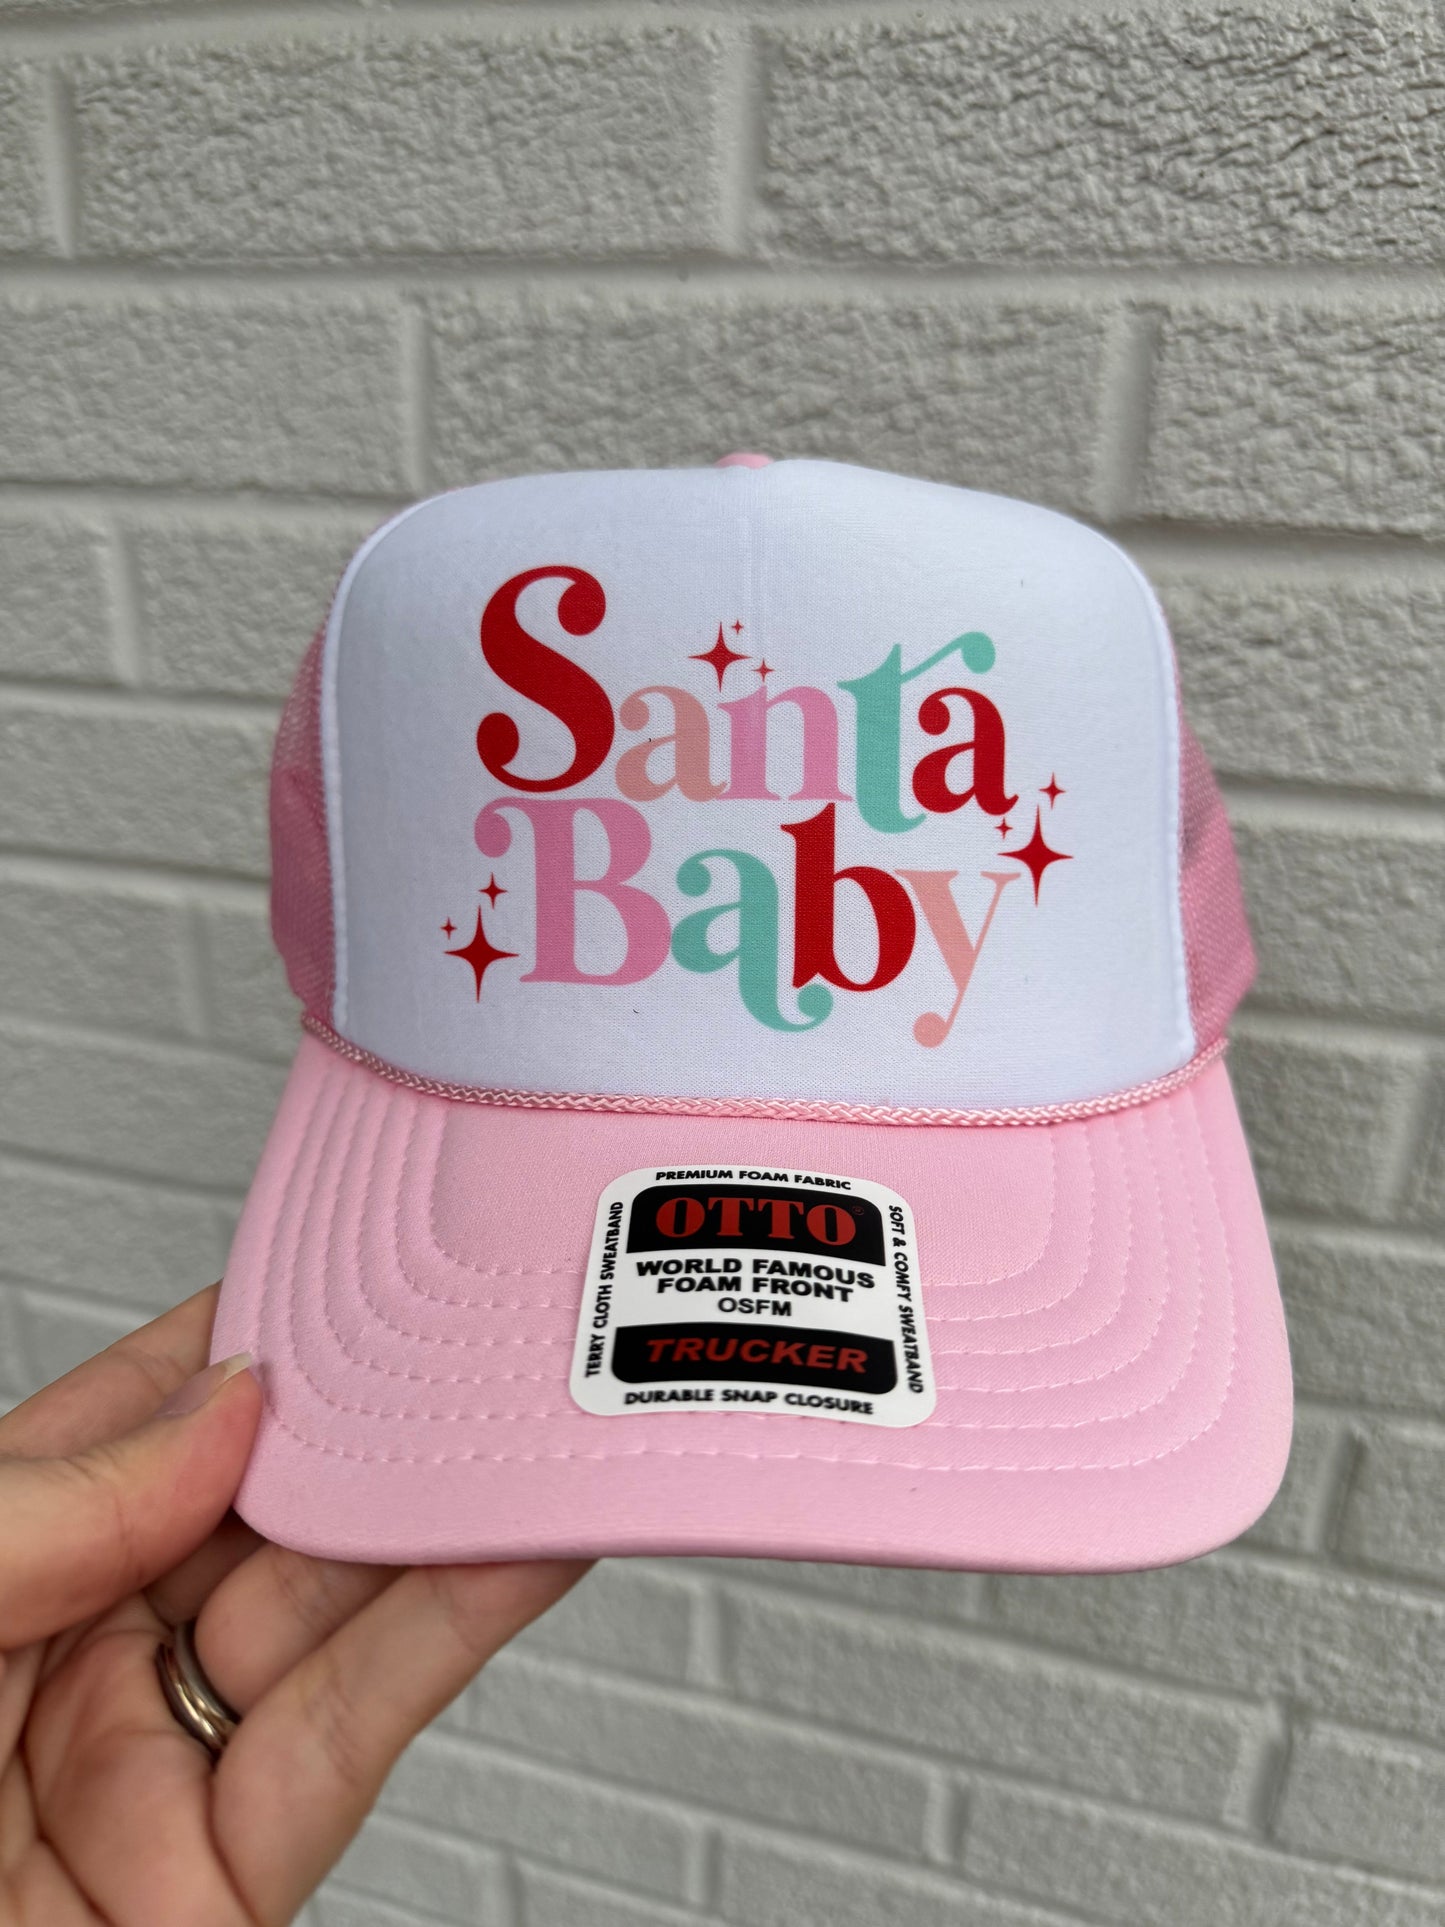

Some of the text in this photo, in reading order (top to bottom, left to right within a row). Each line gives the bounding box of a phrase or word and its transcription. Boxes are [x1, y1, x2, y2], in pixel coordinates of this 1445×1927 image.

[476, 565, 1019, 834] Santa
[474, 797, 1021, 1048] Baby
[655, 1169, 852, 1191] PREMIUM FOAM FABRIC
[656, 1197, 857, 1246] OTTO
[585, 1201, 624, 1378] TERRY CLOTH SWEATBAND
[636, 1258, 875, 1289] WORLD FAMOUS
[657, 1276, 854, 1302] FOAM FRONT
[718, 1297, 792, 1317] OSFM
[889, 1205, 924, 1393] SOFT & COMFY SWEATBAND
[646, 1338, 868, 1374] TRUCKER
[624, 1389, 874, 1415] DURABLE SNAP CLOSURE
